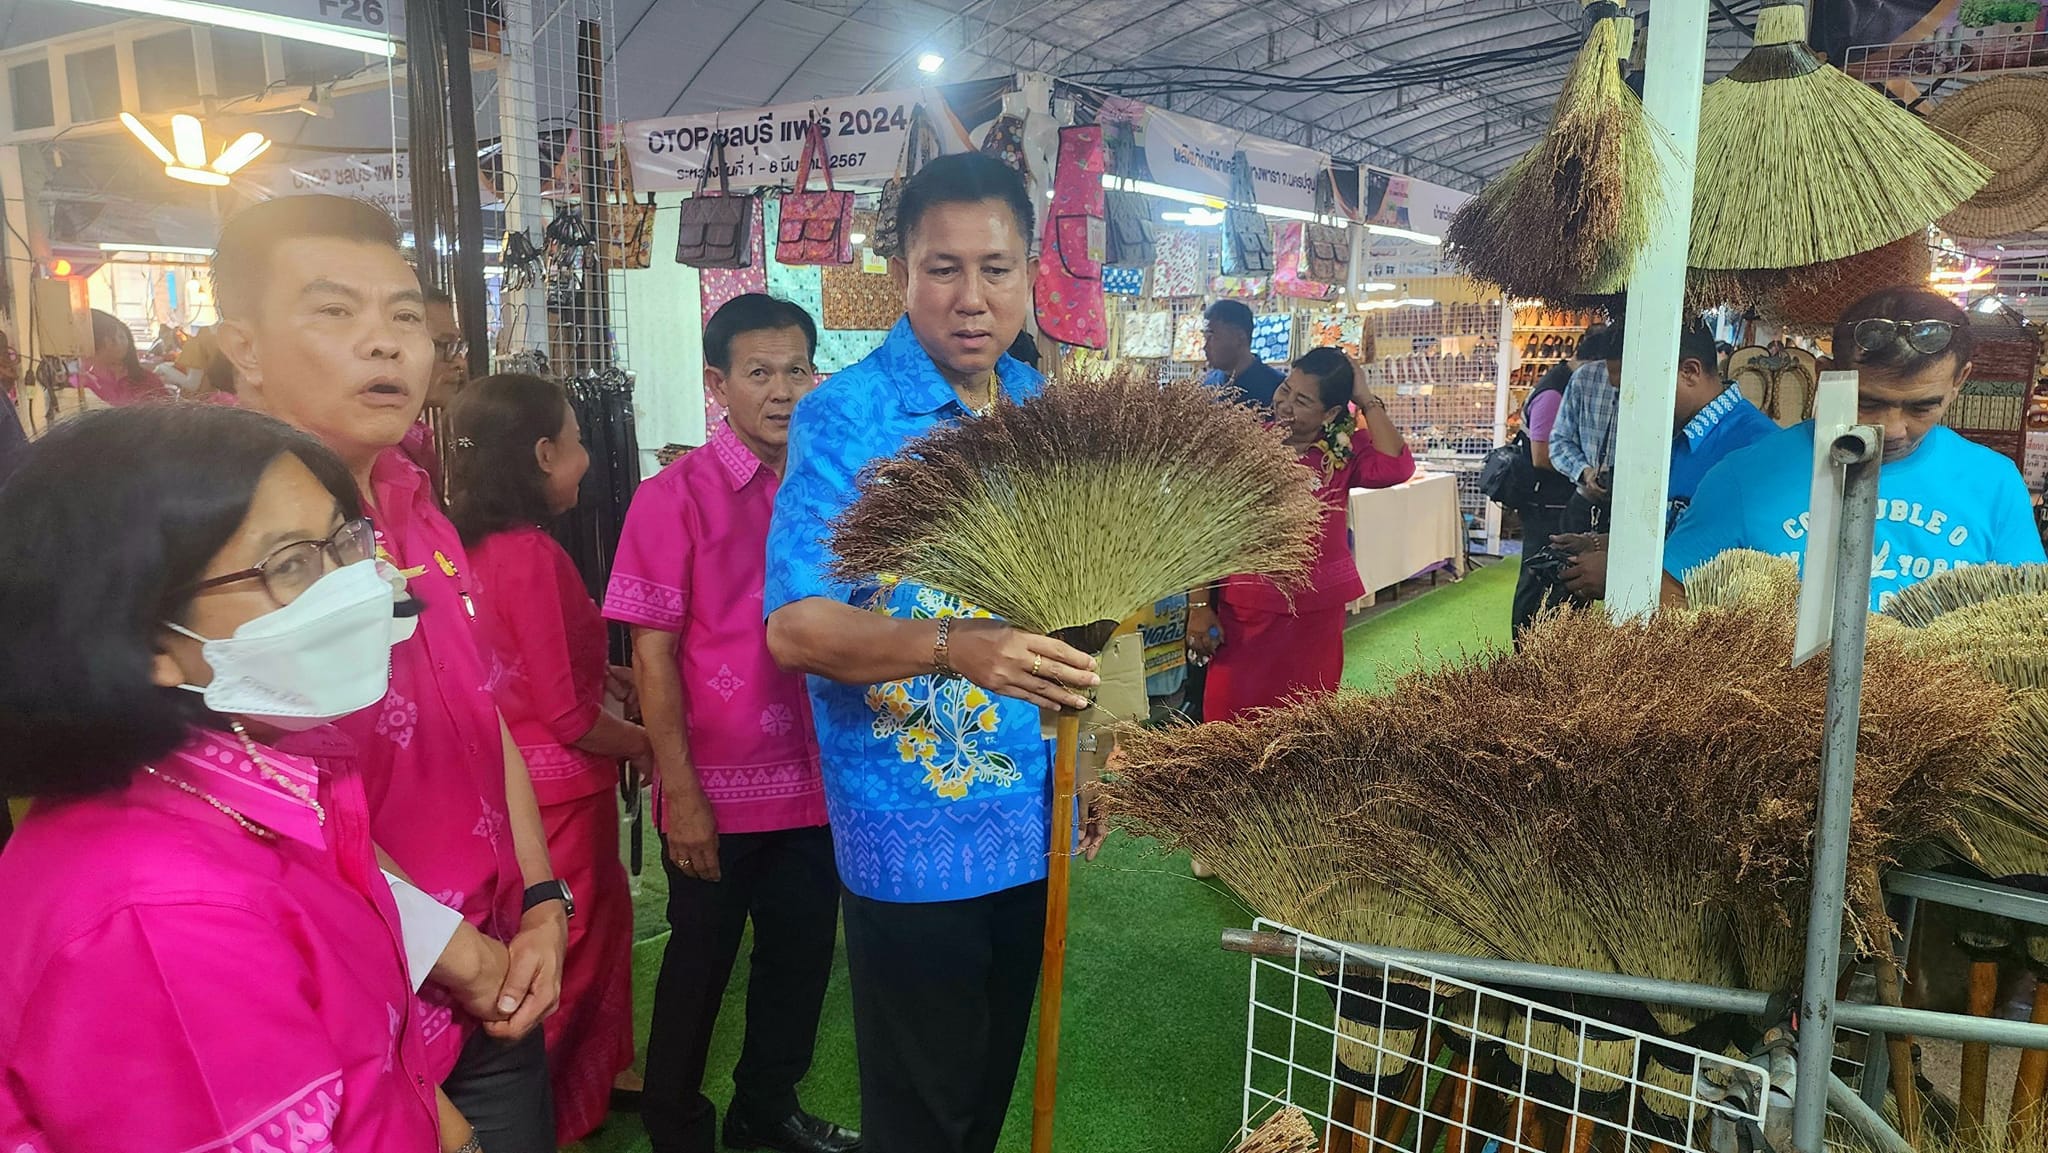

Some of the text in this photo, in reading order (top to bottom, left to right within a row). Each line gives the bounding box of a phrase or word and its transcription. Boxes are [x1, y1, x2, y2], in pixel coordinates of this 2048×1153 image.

[319, 0, 384, 26] F26
[648, 126, 709, 154] OTOP
[838, 105, 907, 137] 2024
[748, 161, 754, 176] 1
[770, 160, 778, 174] 8
[829, 152, 867, 169] 2567
